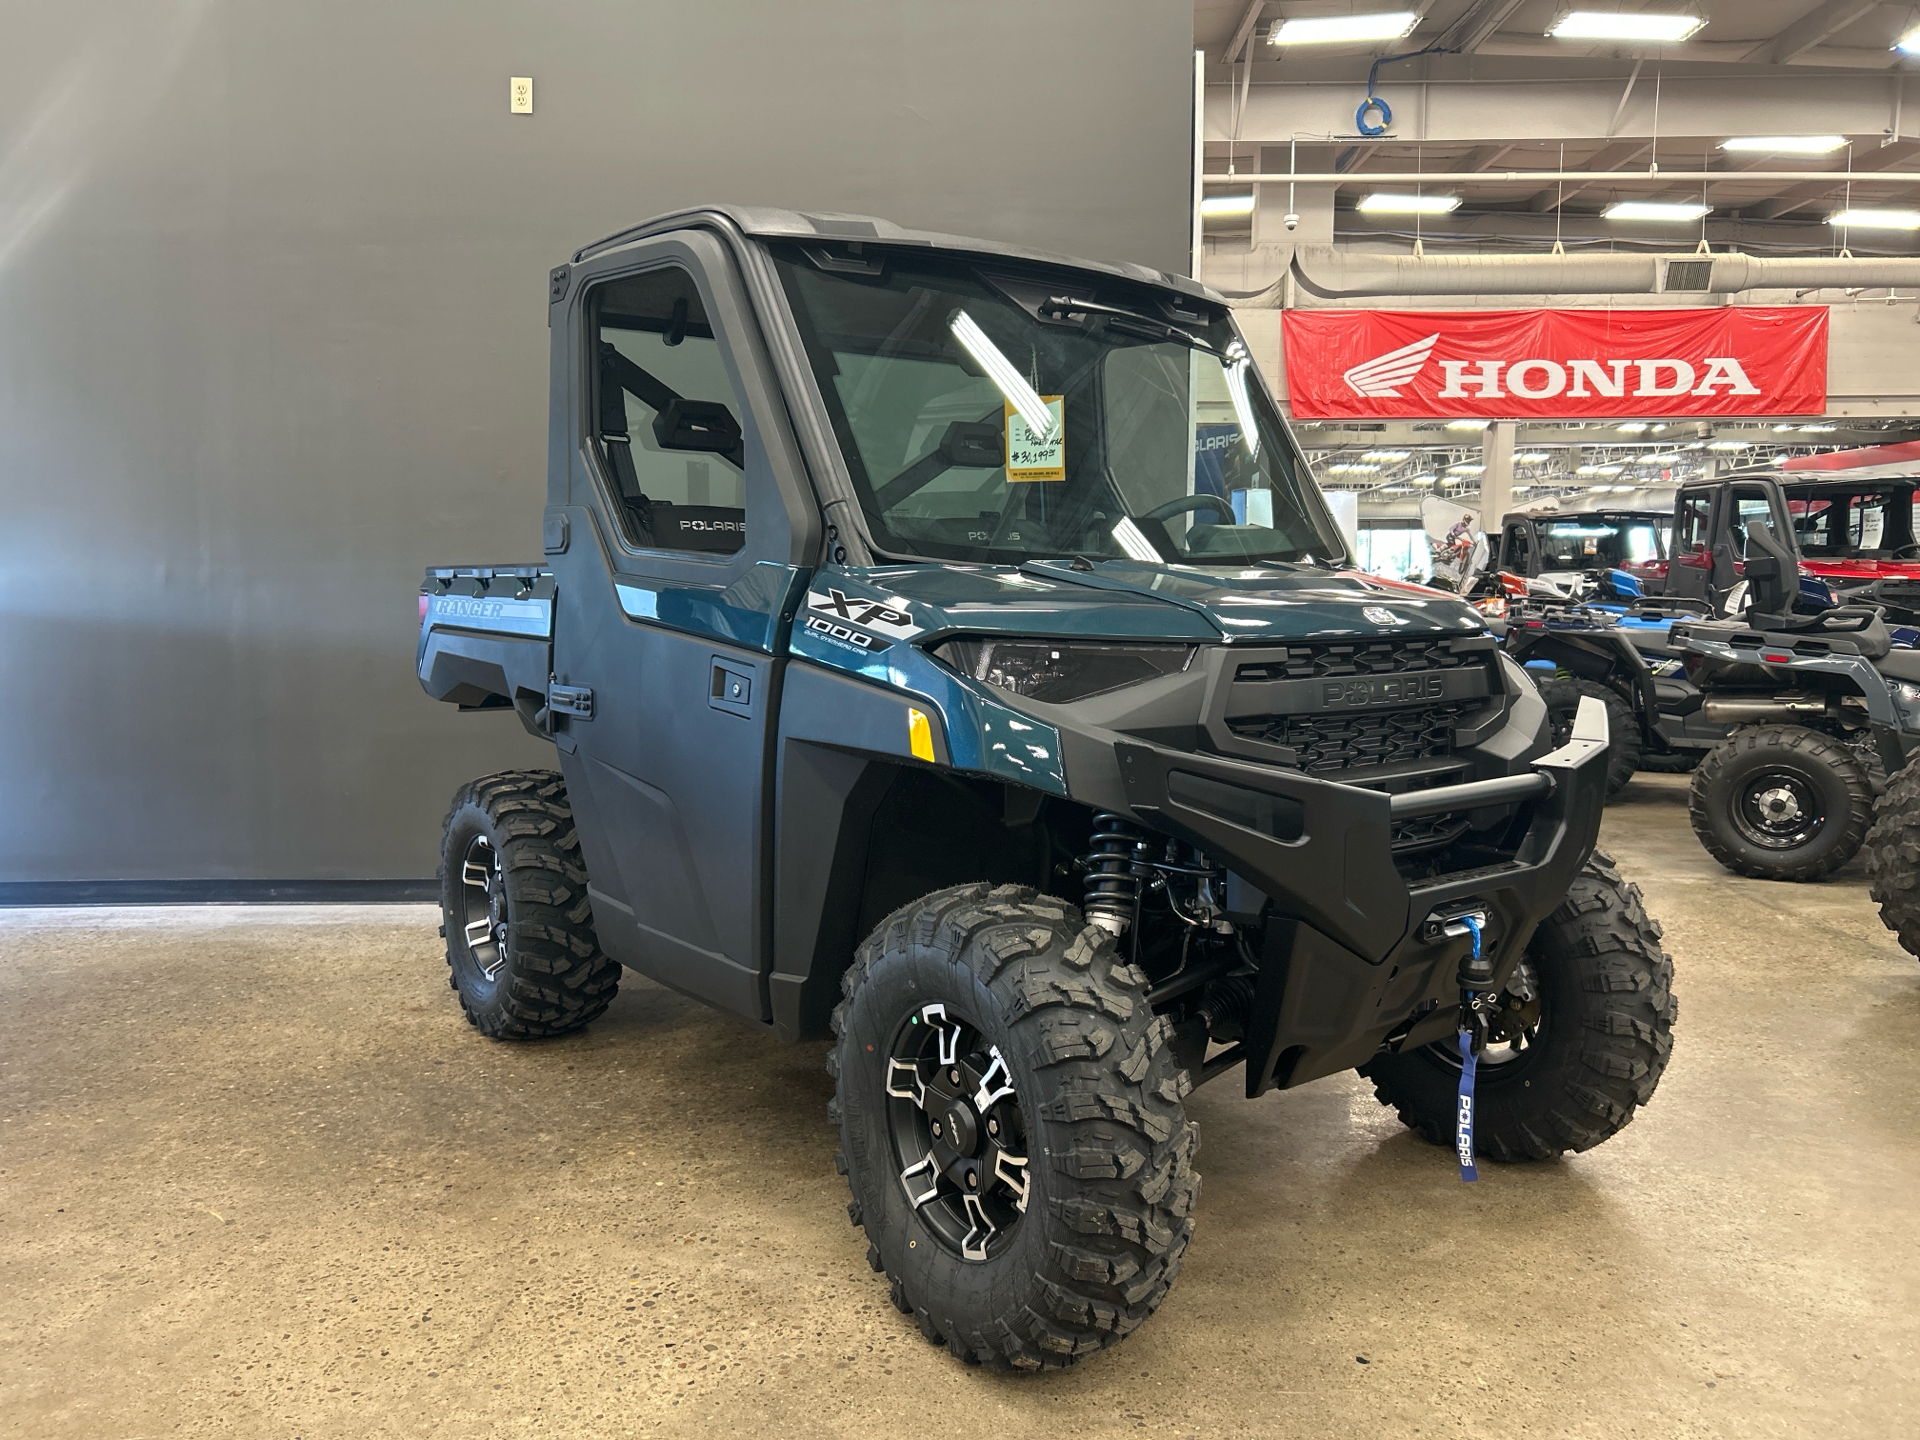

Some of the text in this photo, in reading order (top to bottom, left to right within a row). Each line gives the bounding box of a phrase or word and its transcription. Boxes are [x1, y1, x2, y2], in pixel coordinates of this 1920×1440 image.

[1438, 357, 1761, 399] HONDA
[968, 531, 1021, 541] POLIS
[436, 599, 503, 619] RANGER
[809, 589, 914, 627] XP
[803, 629, 868, 657] DUAL OVERHEAD CAM
[805, 616, 873, 648] 1000
[1322, 674, 1444, 709] POLARIS
[1458, 1094, 1473, 1167] POLARIS
